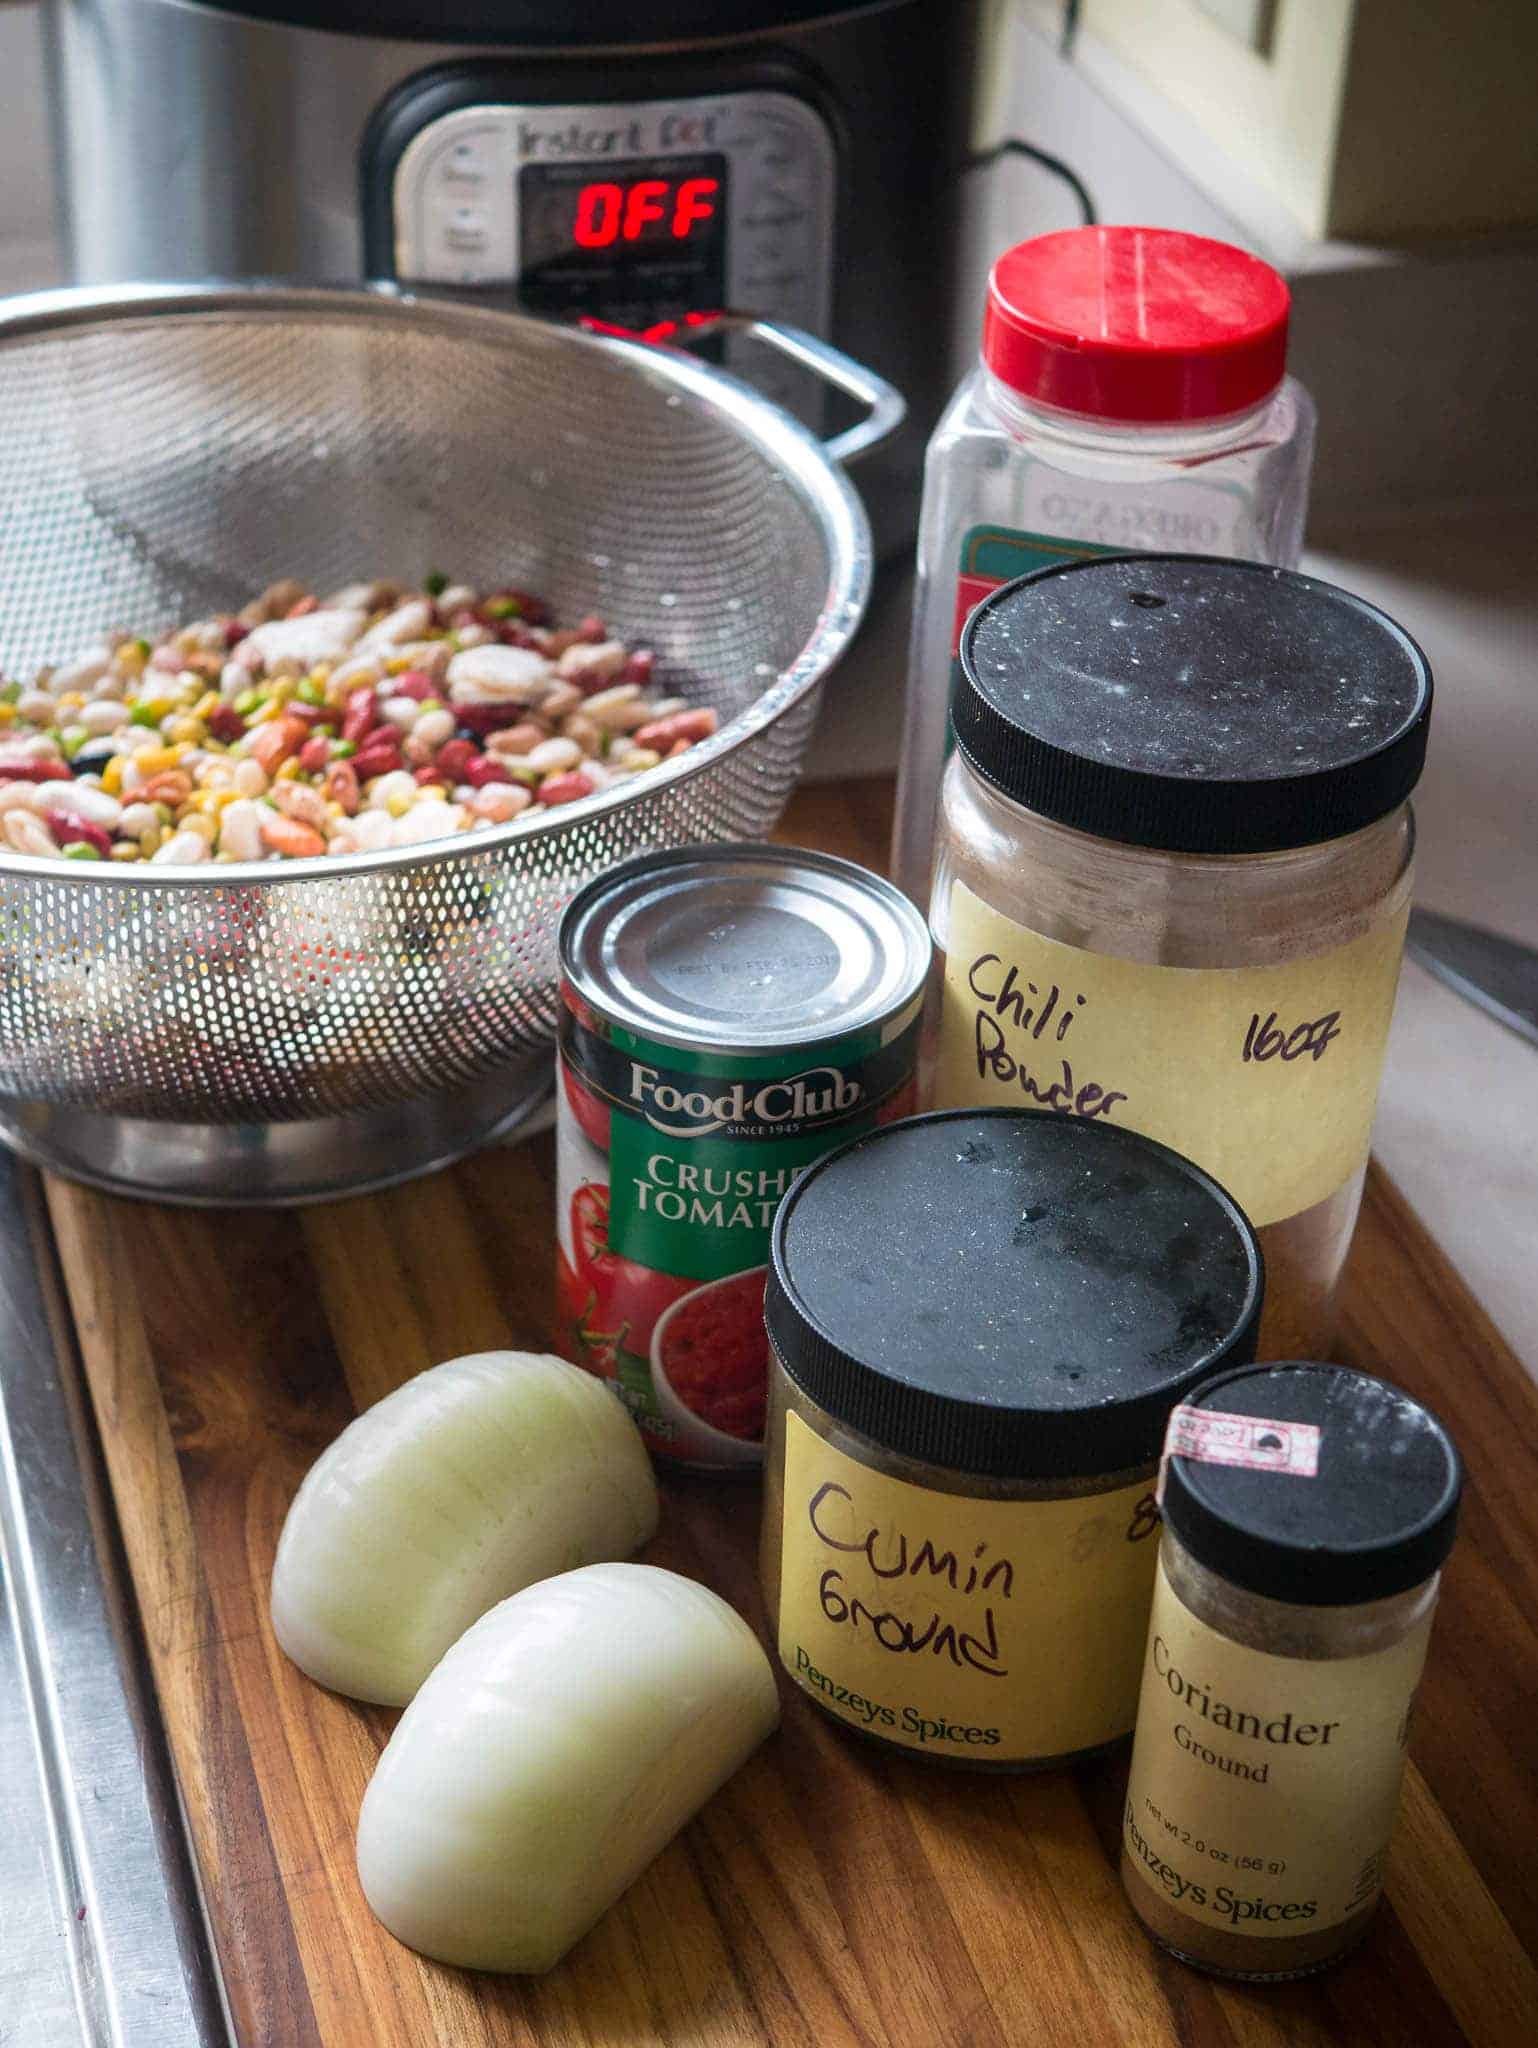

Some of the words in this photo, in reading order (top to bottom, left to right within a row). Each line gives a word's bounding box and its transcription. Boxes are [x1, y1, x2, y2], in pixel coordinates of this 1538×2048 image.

[573, 177, 719, 249] OFF
[968, 953, 1087, 1040] Chili
[975, 1010, 1128, 1118] Powder
[726, 1125, 766, 1136] SINCE
[809, 1481, 1014, 1598] Cumin
[819, 1569, 1008, 1677] Ground
[796, 1646, 895, 1726] Penzeys
[901, 1707, 1000, 1746] Spices
[1153, 1635, 1340, 1746] Coriander
[1174, 1723, 1270, 1784] Ground
[1181, 1831, 1206, 1853] 2.0
[1209, 1847, 1231, 1864] oz
[1234, 1854, 1263, 1871] (56
[1267, 1859, 1287, 1875] g)
[1212, 1886, 1319, 1925] Spices
